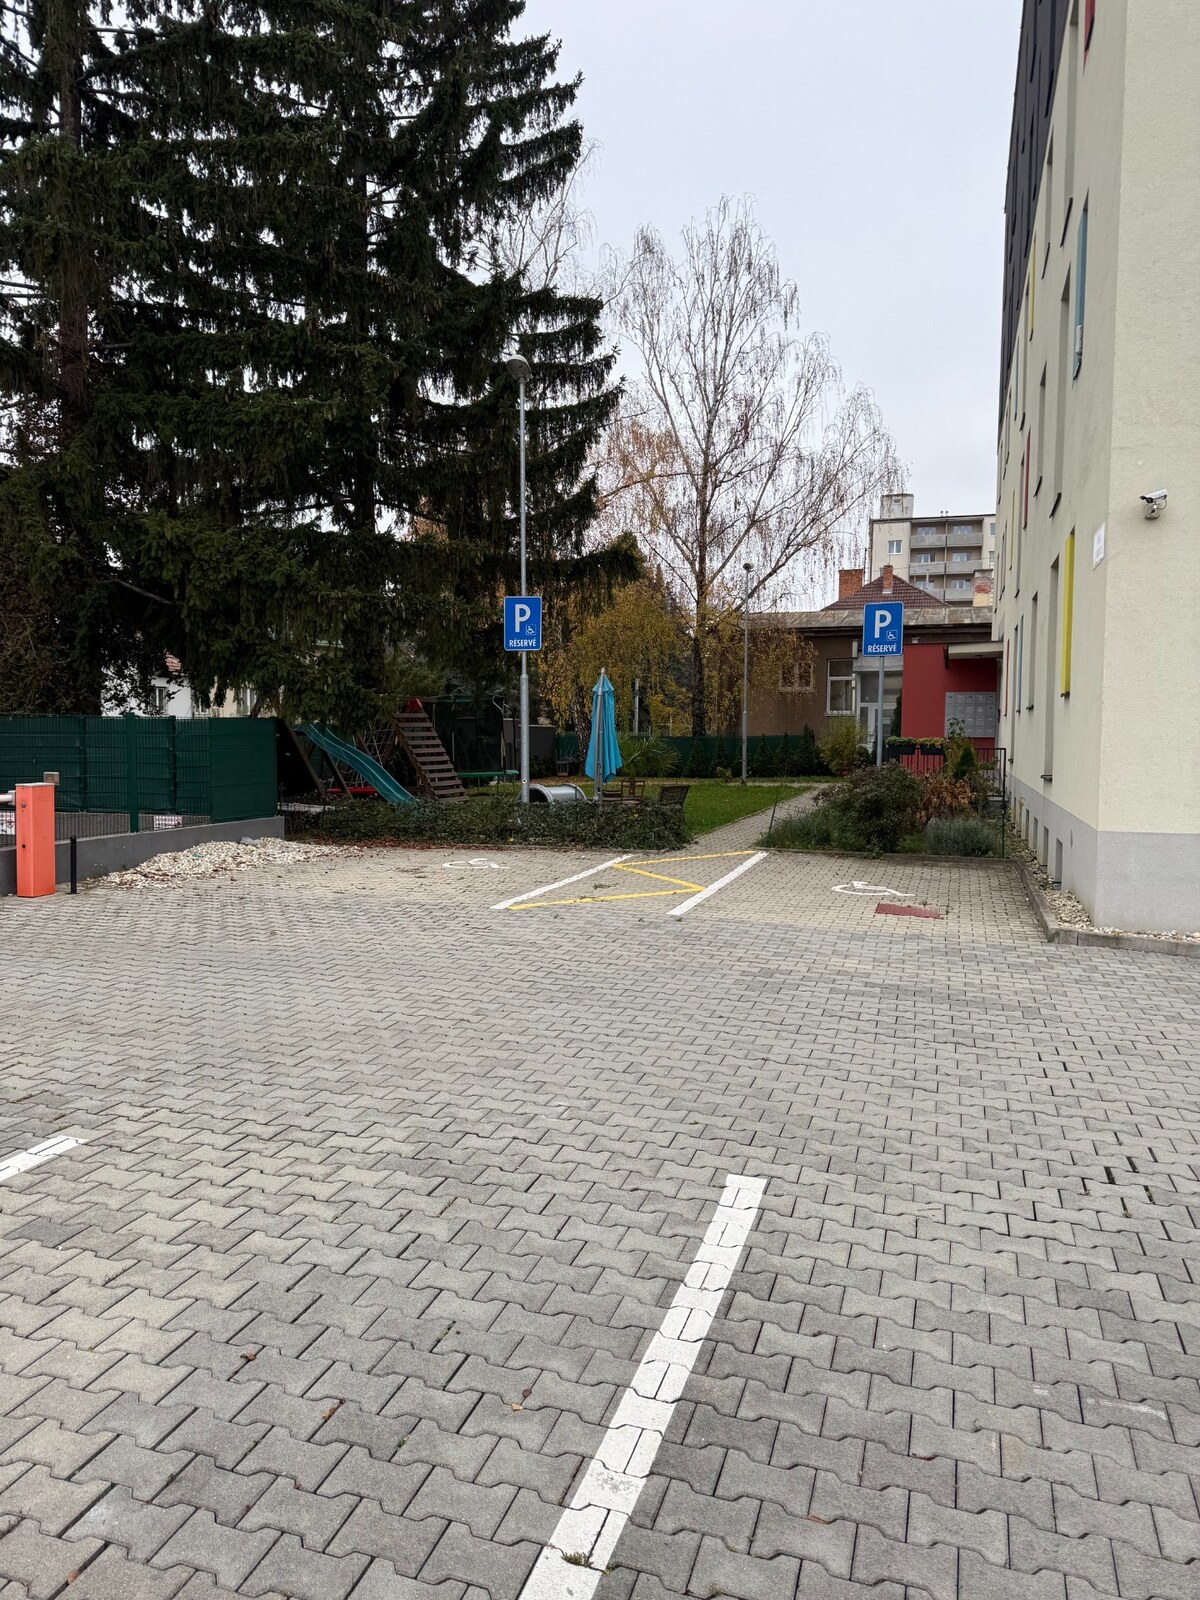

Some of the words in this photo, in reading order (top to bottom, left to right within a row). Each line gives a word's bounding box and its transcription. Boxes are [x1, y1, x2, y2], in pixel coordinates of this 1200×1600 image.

[515, 604, 531, 632] P
[874, 610, 892, 638] P
[867, 643, 897, 653] RÉSERVÉ
